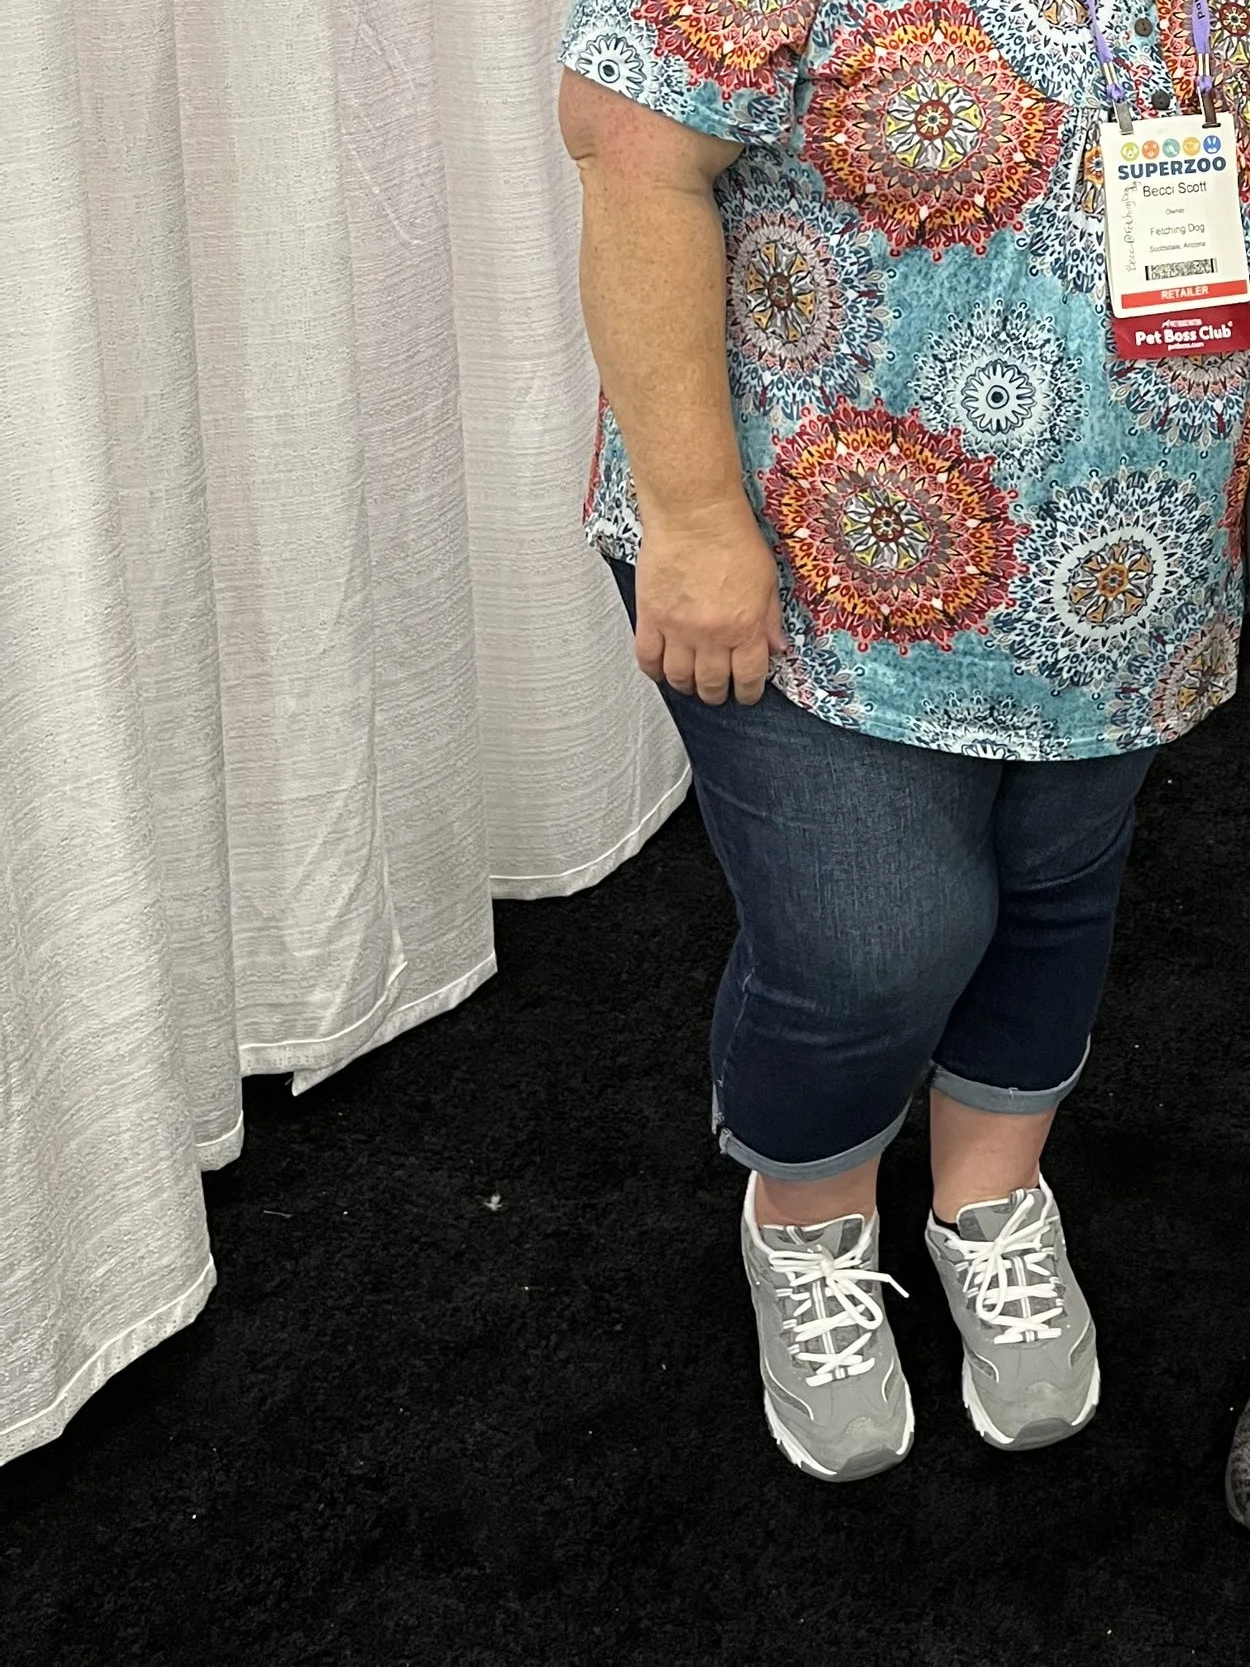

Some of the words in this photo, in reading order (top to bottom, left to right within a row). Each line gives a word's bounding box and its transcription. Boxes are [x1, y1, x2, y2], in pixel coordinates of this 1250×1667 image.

[1118, 156, 1227, 181] SUPERZOO
[1143, 183, 1176, 198] Becci
[1177, 180, 1208, 195] Scott
[1149, 224, 1186, 238] Fetching
[1188, 222, 1205, 235] Dog
[1160, 285, 1209, 300] RETAILER
[1135, 330, 1162, 346] Pet
[1163, 328, 1197, 344] Boss
[1199, 324, 1232, 340] Club
